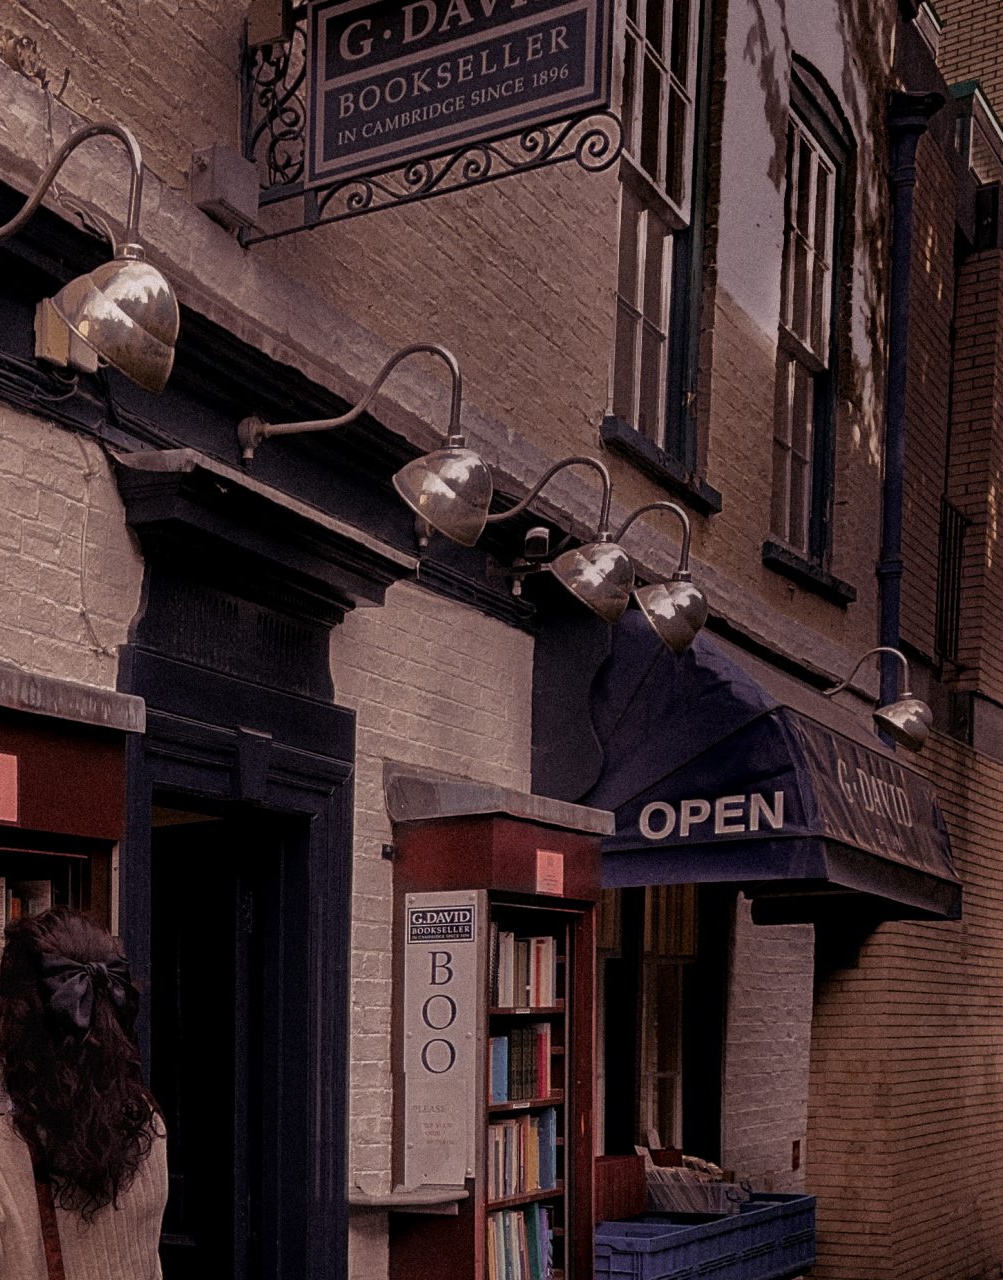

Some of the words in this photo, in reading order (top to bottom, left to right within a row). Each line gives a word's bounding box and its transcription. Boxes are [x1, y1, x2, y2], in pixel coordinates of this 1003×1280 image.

[338, 25, 570, 119] BOOKSELLER
[337, 127, 357, 146] IN
[361, 95, 465, 138] CAMBRIDGE
[470, 76, 525, 107] SINCE
[530, 63, 570, 89] 1896
[639, 790, 785, 840] OPEN
[411, 925, 470, 935] BOOKSELLER
[412, 910, 471, 924] G.DAVID
